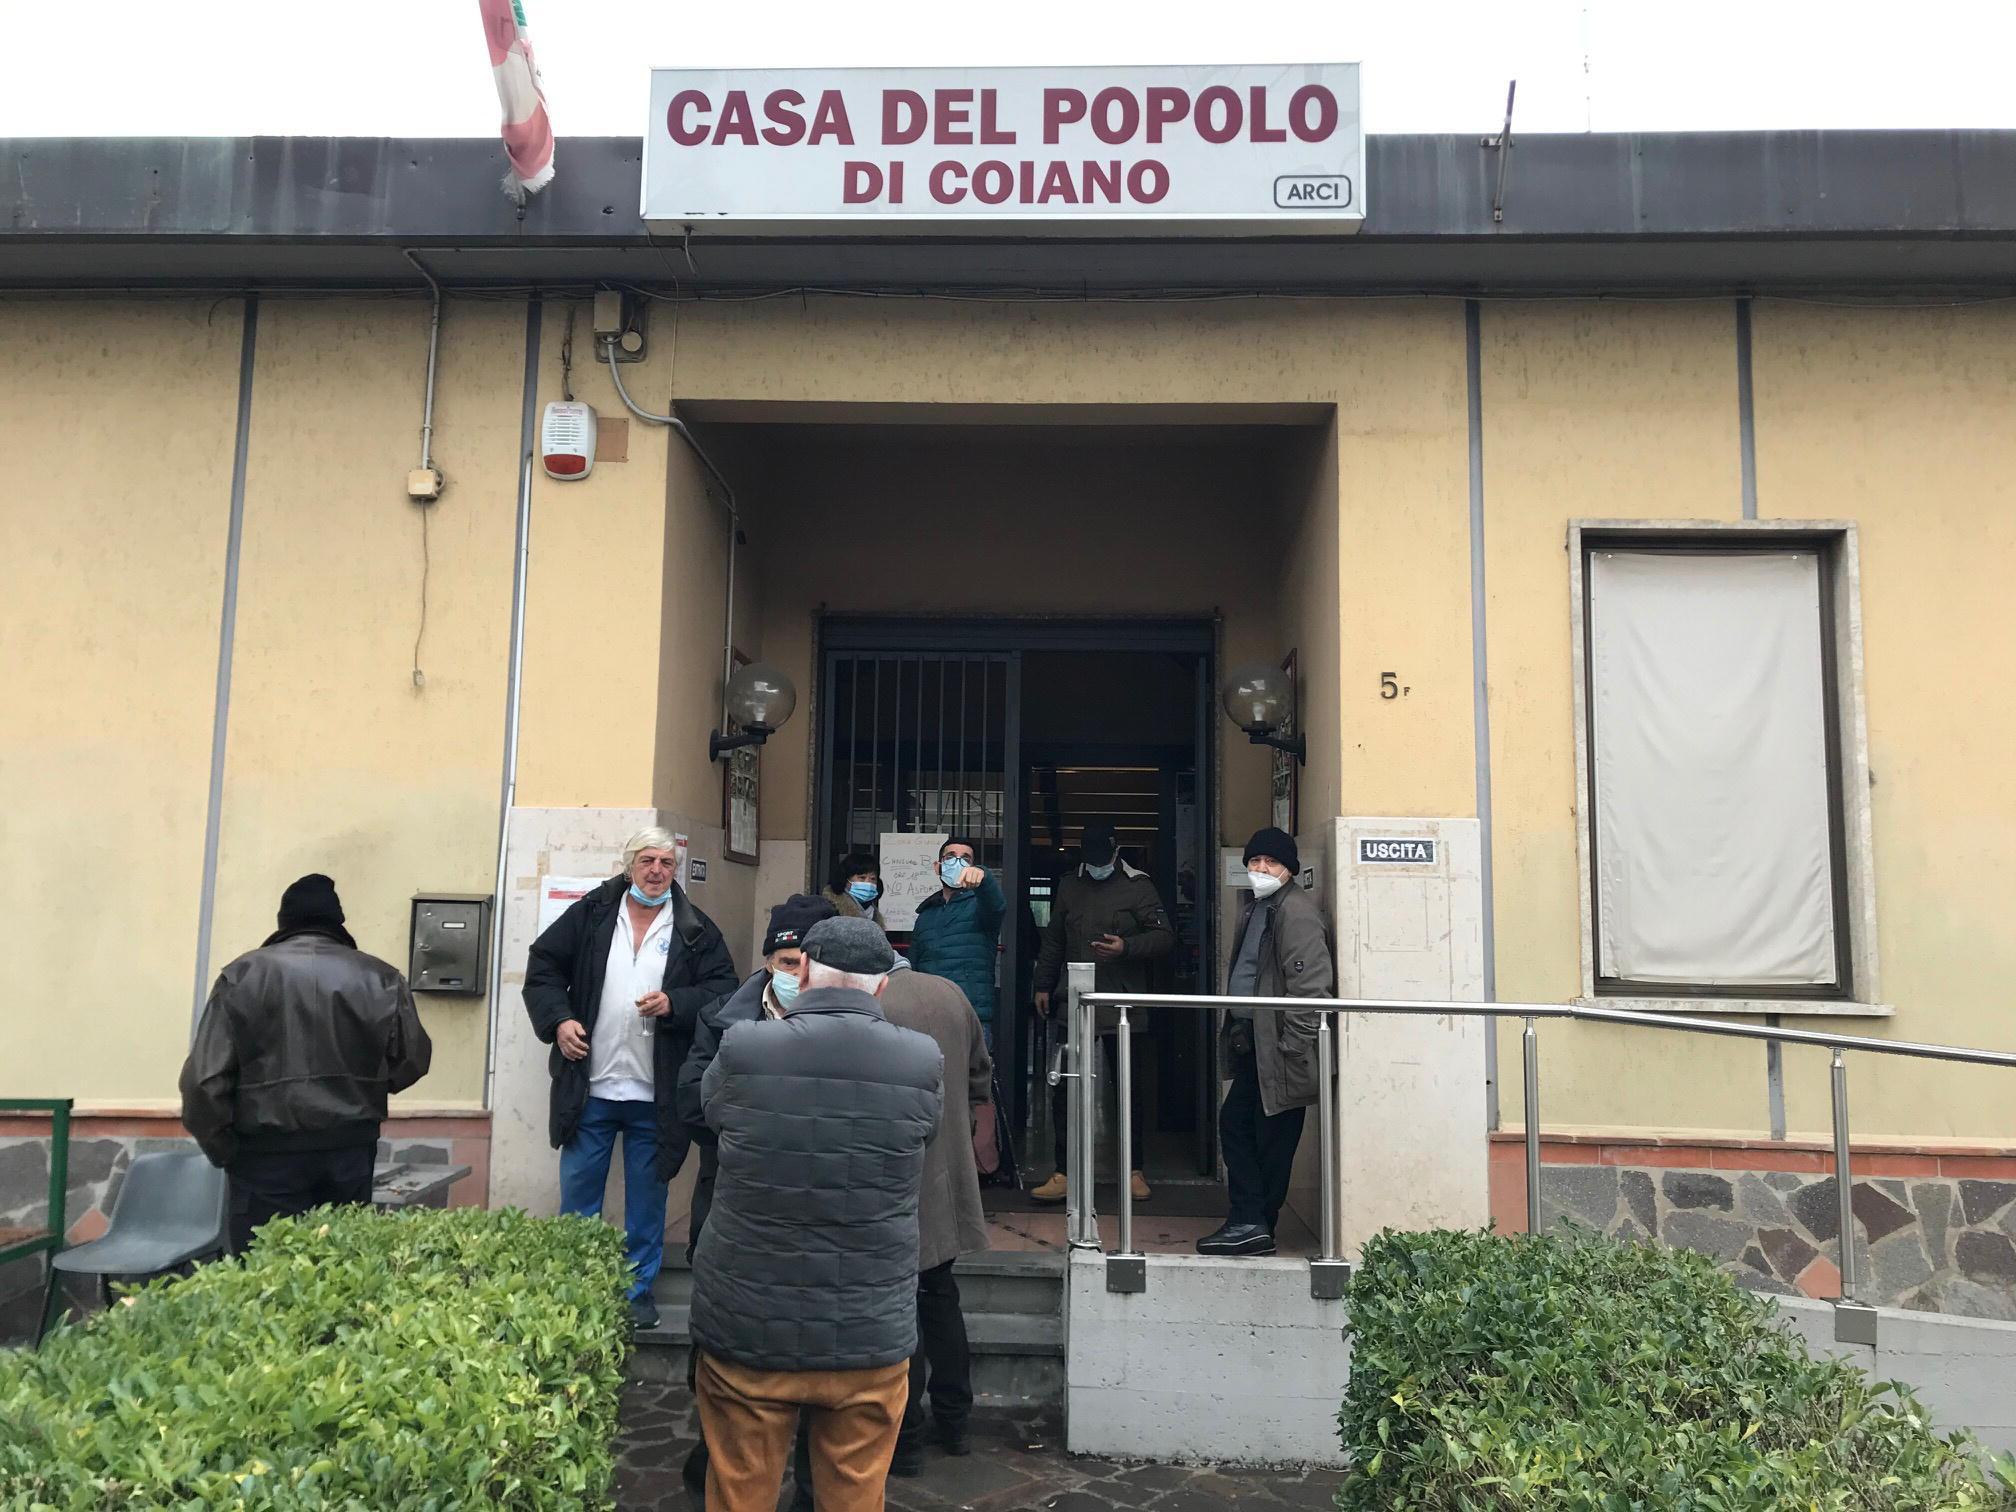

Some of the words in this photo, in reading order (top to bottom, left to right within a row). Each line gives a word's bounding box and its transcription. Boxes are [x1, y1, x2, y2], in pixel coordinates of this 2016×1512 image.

[666, 88, 855, 146] CASA
[881, 88, 1016, 145] DEL
[1043, 84, 1339, 144] POPOLO
[842, 160, 903, 205] DI
[929, 159, 1171, 205] COIANO
[1286, 181, 1340, 201] ARCI
[1380, 671, 1398, 700] 5
[1403, 686, 1411, 697] F
[1366, 842, 1427, 859] USCITA
